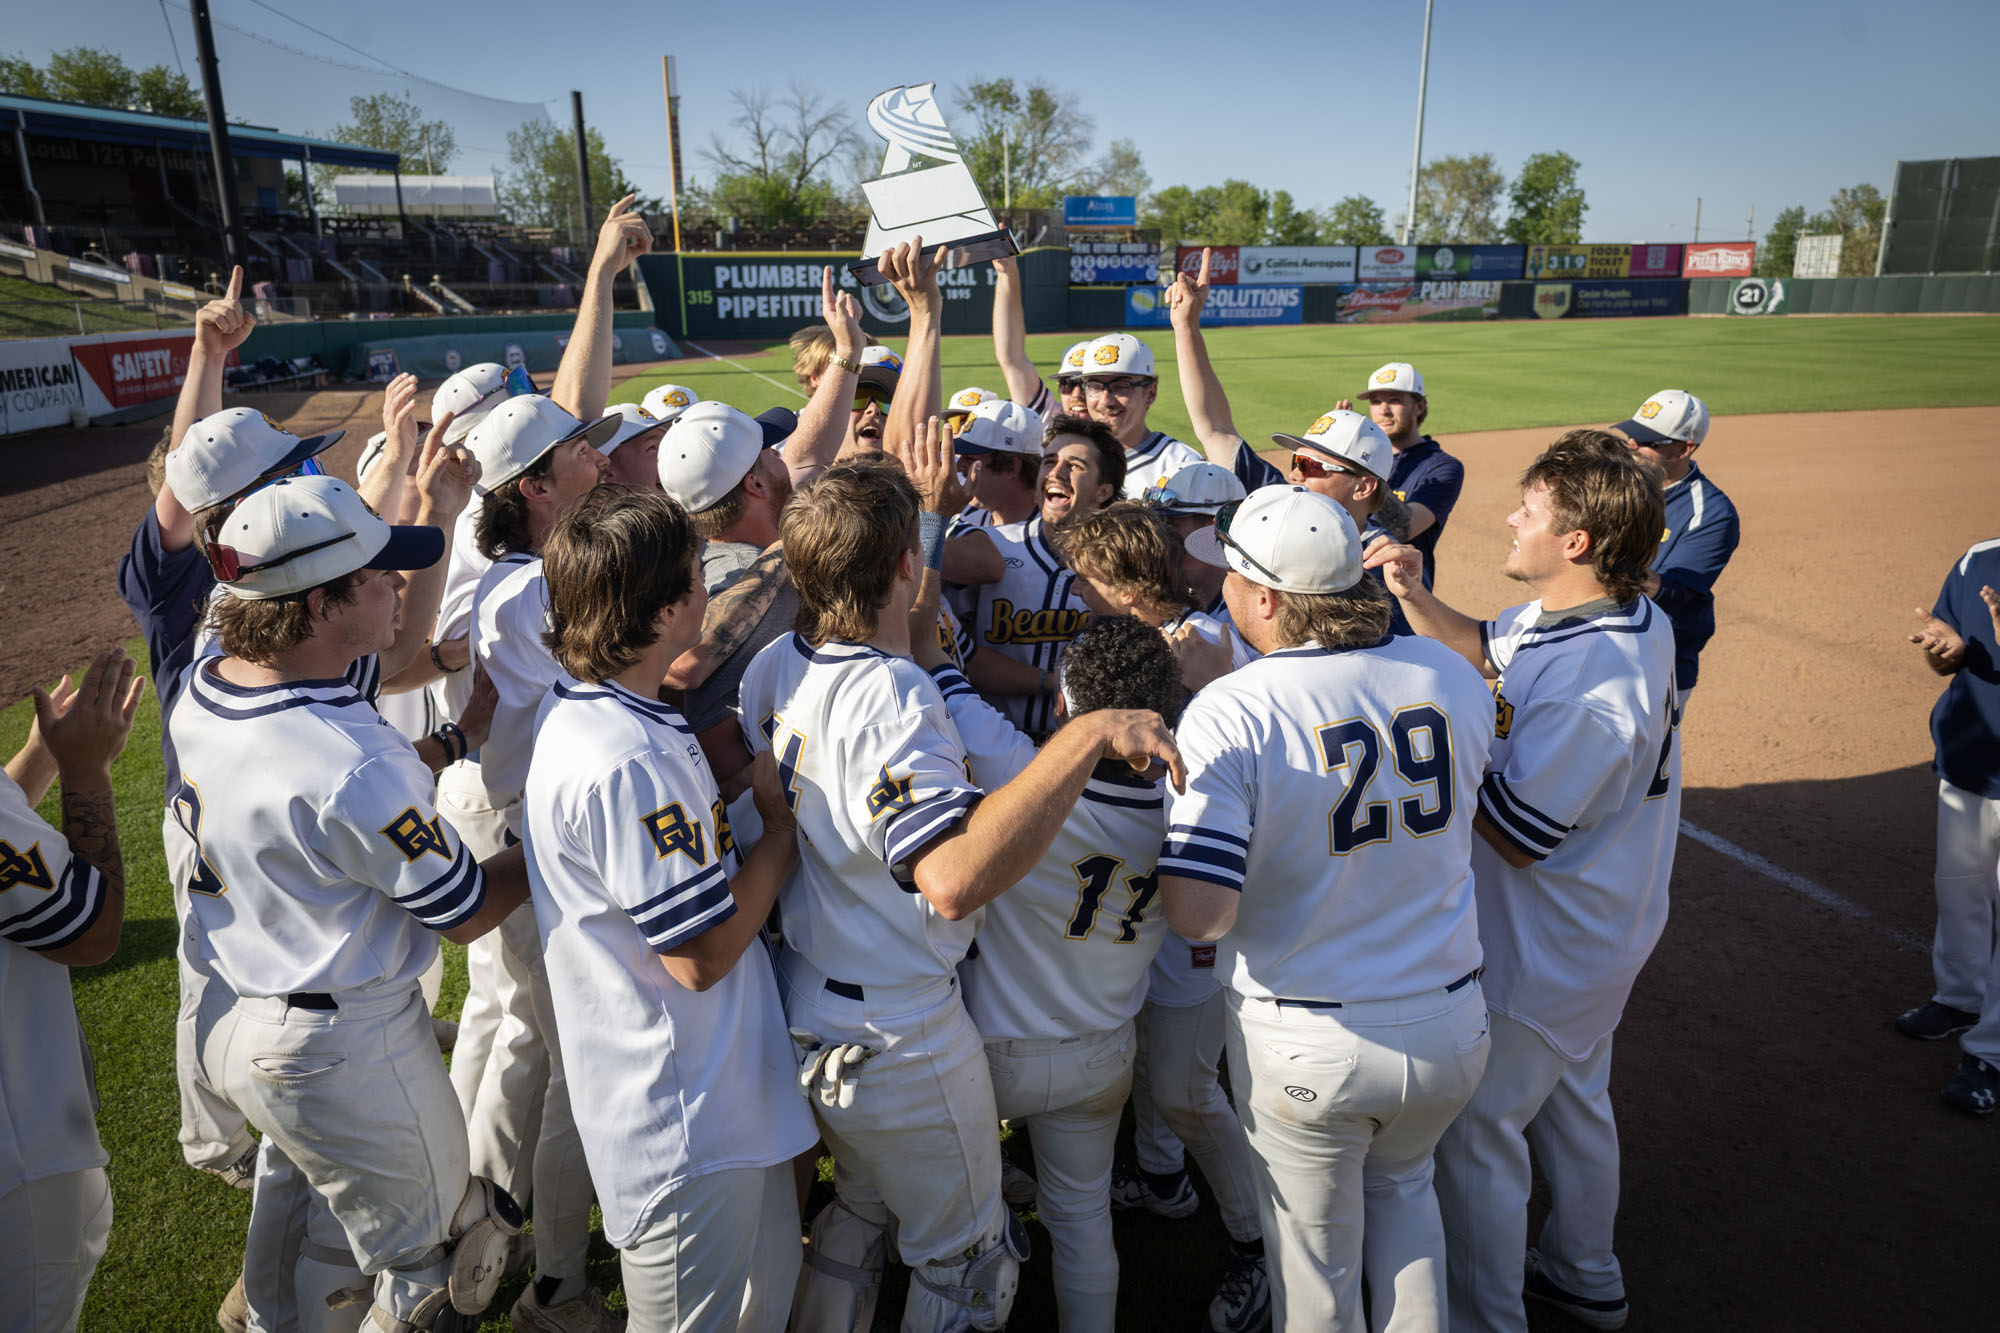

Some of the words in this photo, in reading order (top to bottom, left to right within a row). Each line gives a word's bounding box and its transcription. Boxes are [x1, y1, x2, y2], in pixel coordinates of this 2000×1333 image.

[27, 138, 79, 160] Local
[88, 144, 126, 166] 125
[1590, 257, 1623, 266] TICKET
[1591, 247, 1620, 256] FOOD
[1718, 252, 1750, 269] Ranch
[1265, 257, 1299, 269] Collins
[1301, 257, 1352, 271] Aerospace
[936, 267, 977, 287] OCAL
[687, 290, 713, 305] 315
[947, 288, 971, 300] 1895
[1206, 288, 1299, 308] SOLUTIONS
[1420, 281, 1457, 300] PLAY
[1458, 280, 1497, 299] BALL!
[1740, 288, 1760, 303] 21
[717, 294, 824, 319] PIPEFITTE
[112, 349, 172, 382] SAFETY
[0, 364, 74, 392] MERICAN
[13, 386, 77, 413] COMPANY
[1314, 701, 1455, 856] 29
[377, 805, 454, 864] BV
[638, 801, 707, 869] BV
[1064, 853, 1160, 944] 11
